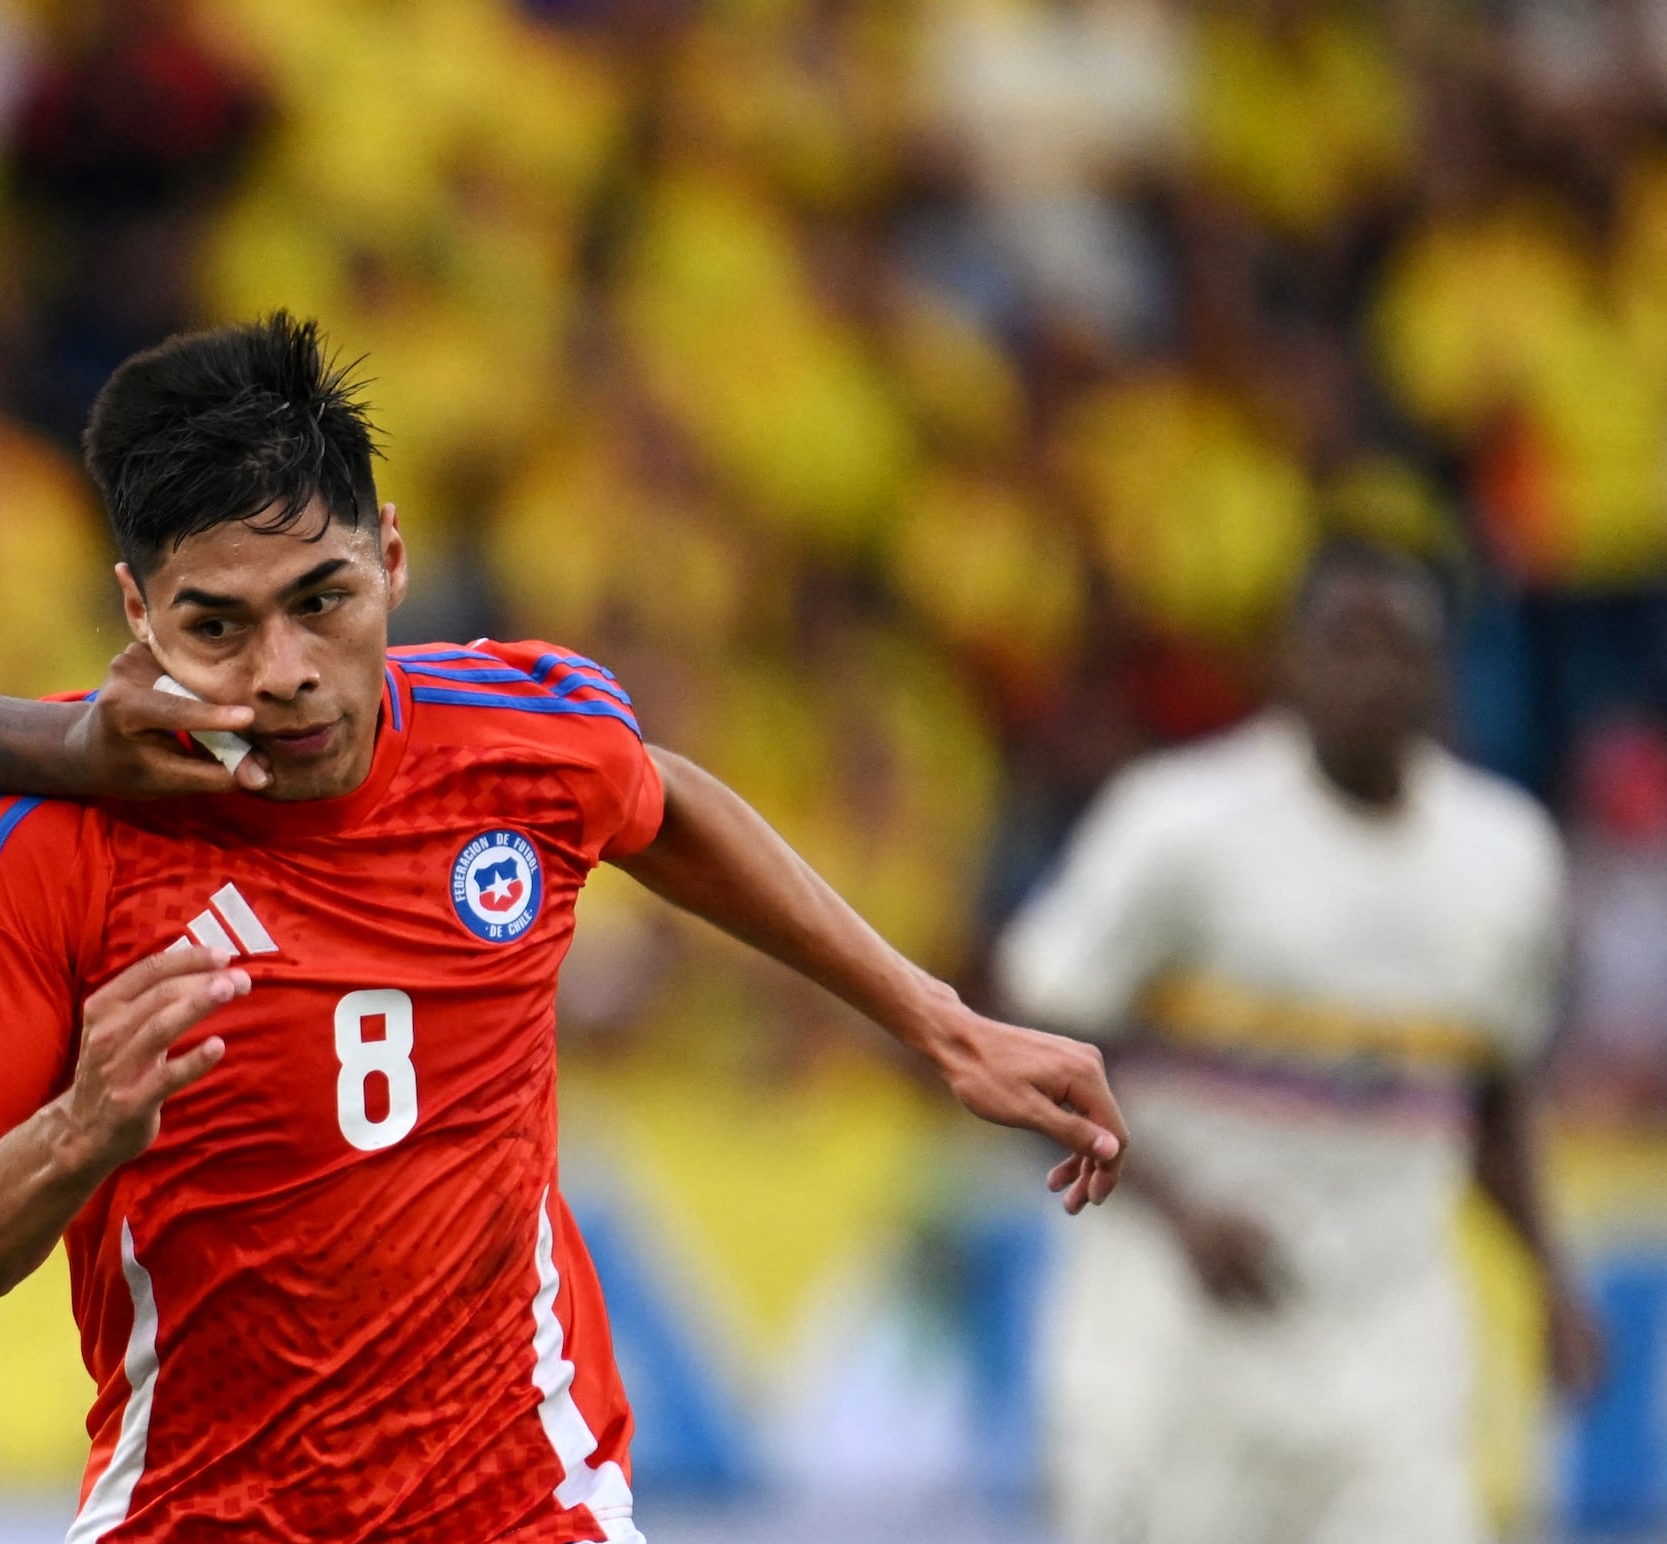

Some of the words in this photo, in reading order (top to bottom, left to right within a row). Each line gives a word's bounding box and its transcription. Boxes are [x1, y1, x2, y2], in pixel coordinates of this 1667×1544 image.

[453, 837, 489, 902] FEDERACION
[496, 833, 510, 846] DE
[513, 837, 539, 875] FUTBOL
[489, 924, 503, 938] DE
[507, 909, 533, 936] CHILE
[334, 988, 419, 1152] 8
